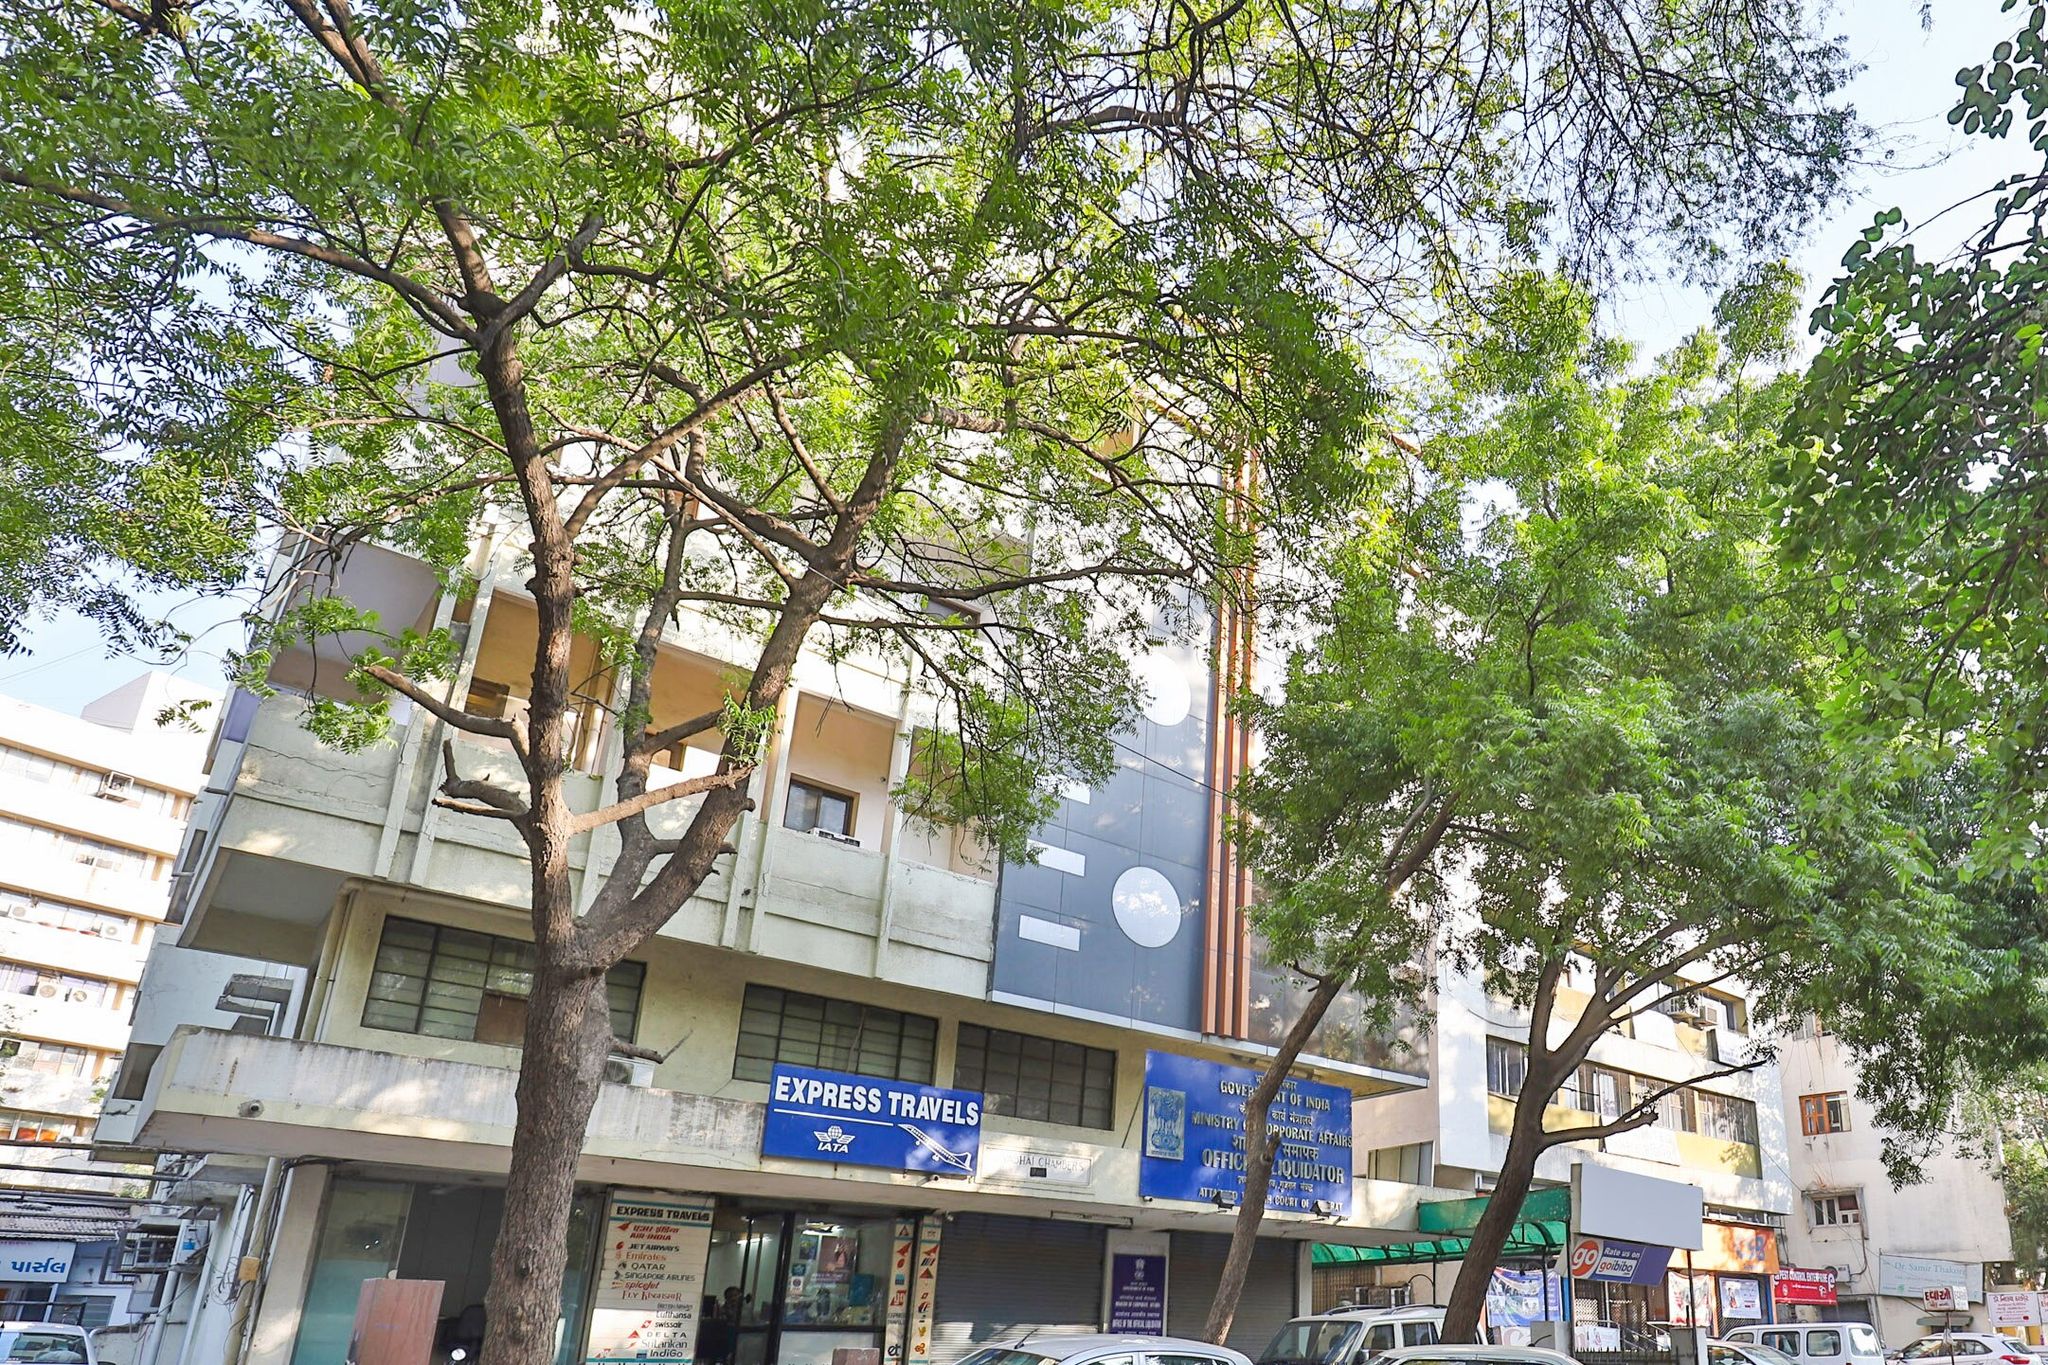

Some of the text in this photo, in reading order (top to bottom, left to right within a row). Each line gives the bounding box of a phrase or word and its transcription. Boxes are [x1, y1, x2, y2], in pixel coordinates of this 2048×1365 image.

[775, 1076, 979, 1126] EXPRESS TRAVELS
[1220, 1080, 1331, 1112] GOVERNT OF INDIA
[1192, 1111, 1240, 1131] MINISTRY
[1266, 1123, 1315, 1142] ORPORATE
[1318, 1130, 1353, 1149] AFFAIRS
[817, 1142, 849, 1154] IATA
[1202, 1148, 1248, 1172] OFFICI
[1271, 1159, 1345, 1184] LIQUIDATOR
[1199, 1187, 1239, 1201] ATTAD
[1275, 1195, 1298, 1208] COURT
[617, 1206, 711, 1222] EXPRESS TRAVELS
[626, 1251, 668, 1261] Emirates
[1571, 1248, 1599, 1270] go
[1604, 1247, 1620, 1257] Rate
[11, 1257, 67, 1274] પાર્સલ
[631, 1262, 667, 1271] QATAR
[1599, 1259, 1633, 1273] goibibo
[624, 1271, 665, 1281] SINGAPORE
[647, 1331, 687, 1339] DELTA
[650, 1349, 683, 1358] IndiGo
